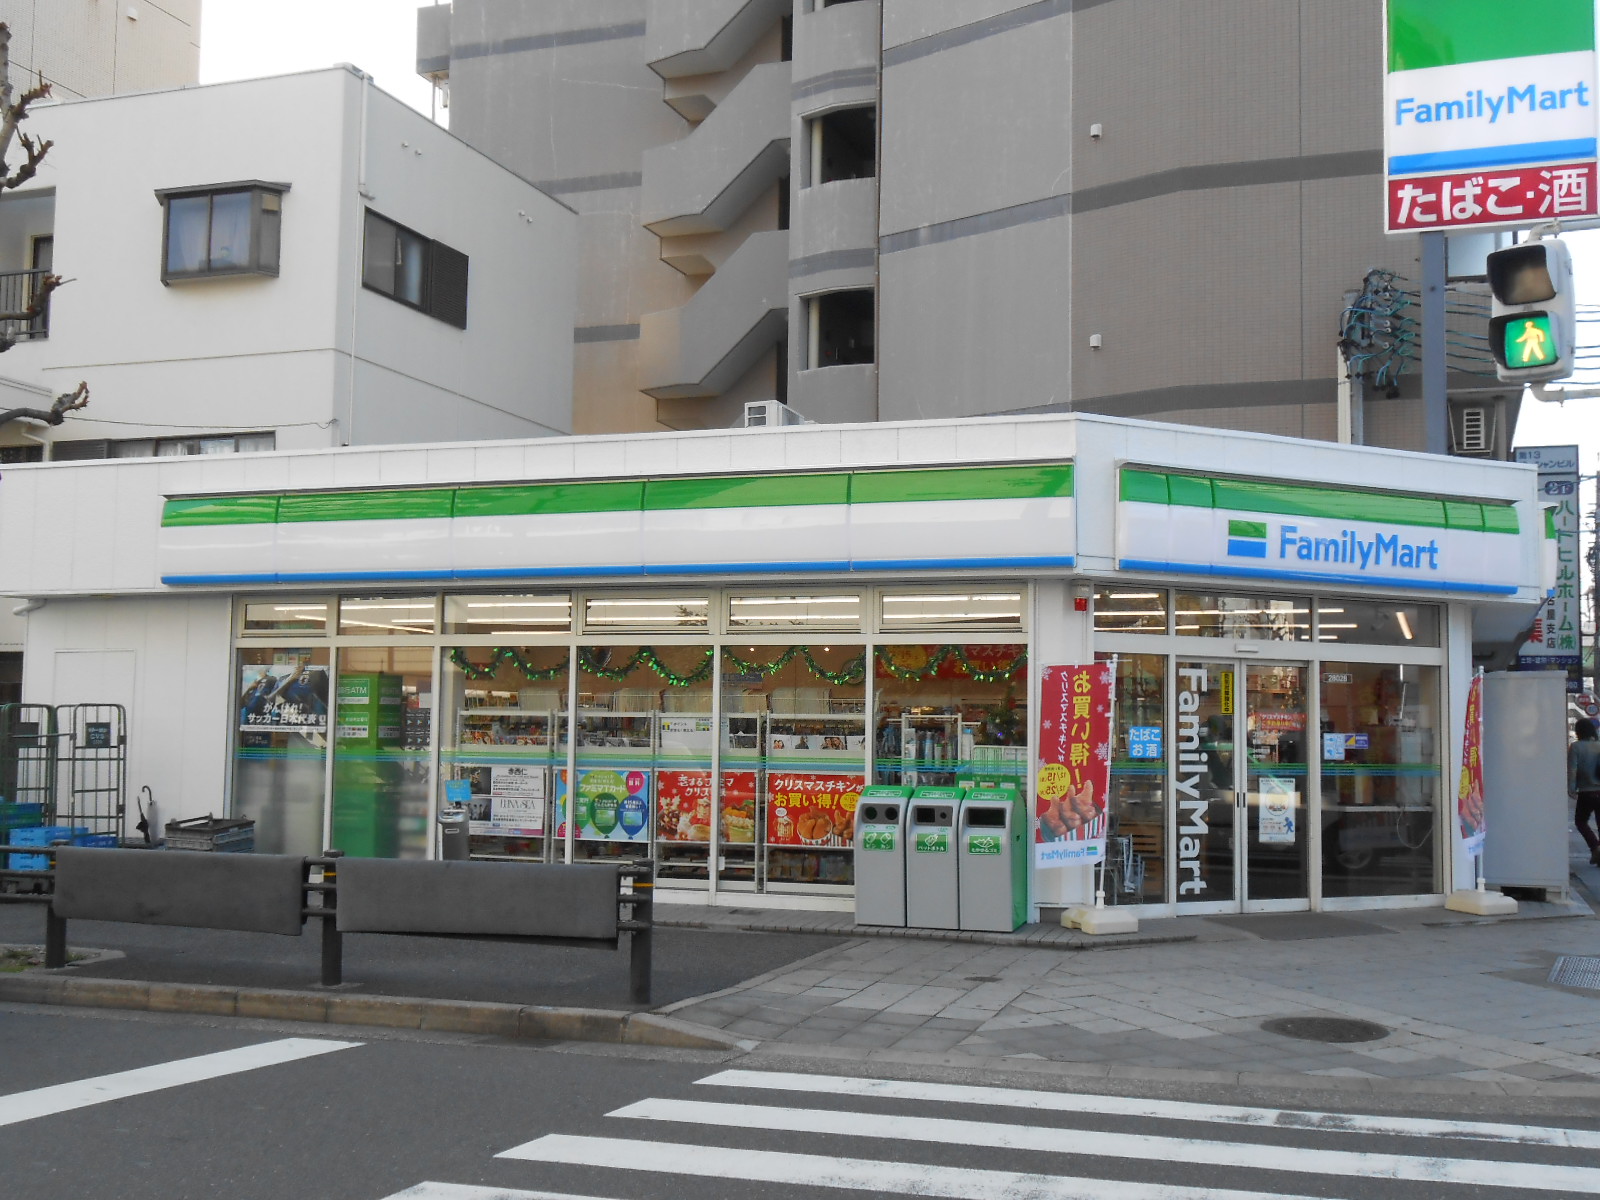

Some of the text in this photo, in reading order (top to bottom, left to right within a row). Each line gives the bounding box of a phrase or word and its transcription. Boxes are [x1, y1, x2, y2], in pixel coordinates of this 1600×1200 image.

[1395, 81, 1589, 125] FamilyMart
[1397, 168, 1588, 224] たばこ・酒
[1279, 525, 1439, 570] FamilyMart
[263, 703, 303, 713] がんばれ!
[247, 713, 317, 725] サッカー日本代表
[1129, 728, 1160, 741] たばこ
[1132, 744, 1158, 757] お酒
[774, 779, 864, 792] クリスマスチキンが
[1176, 668, 1209, 895] FamilyMart
[774, 792, 839, 810] お買い得!
